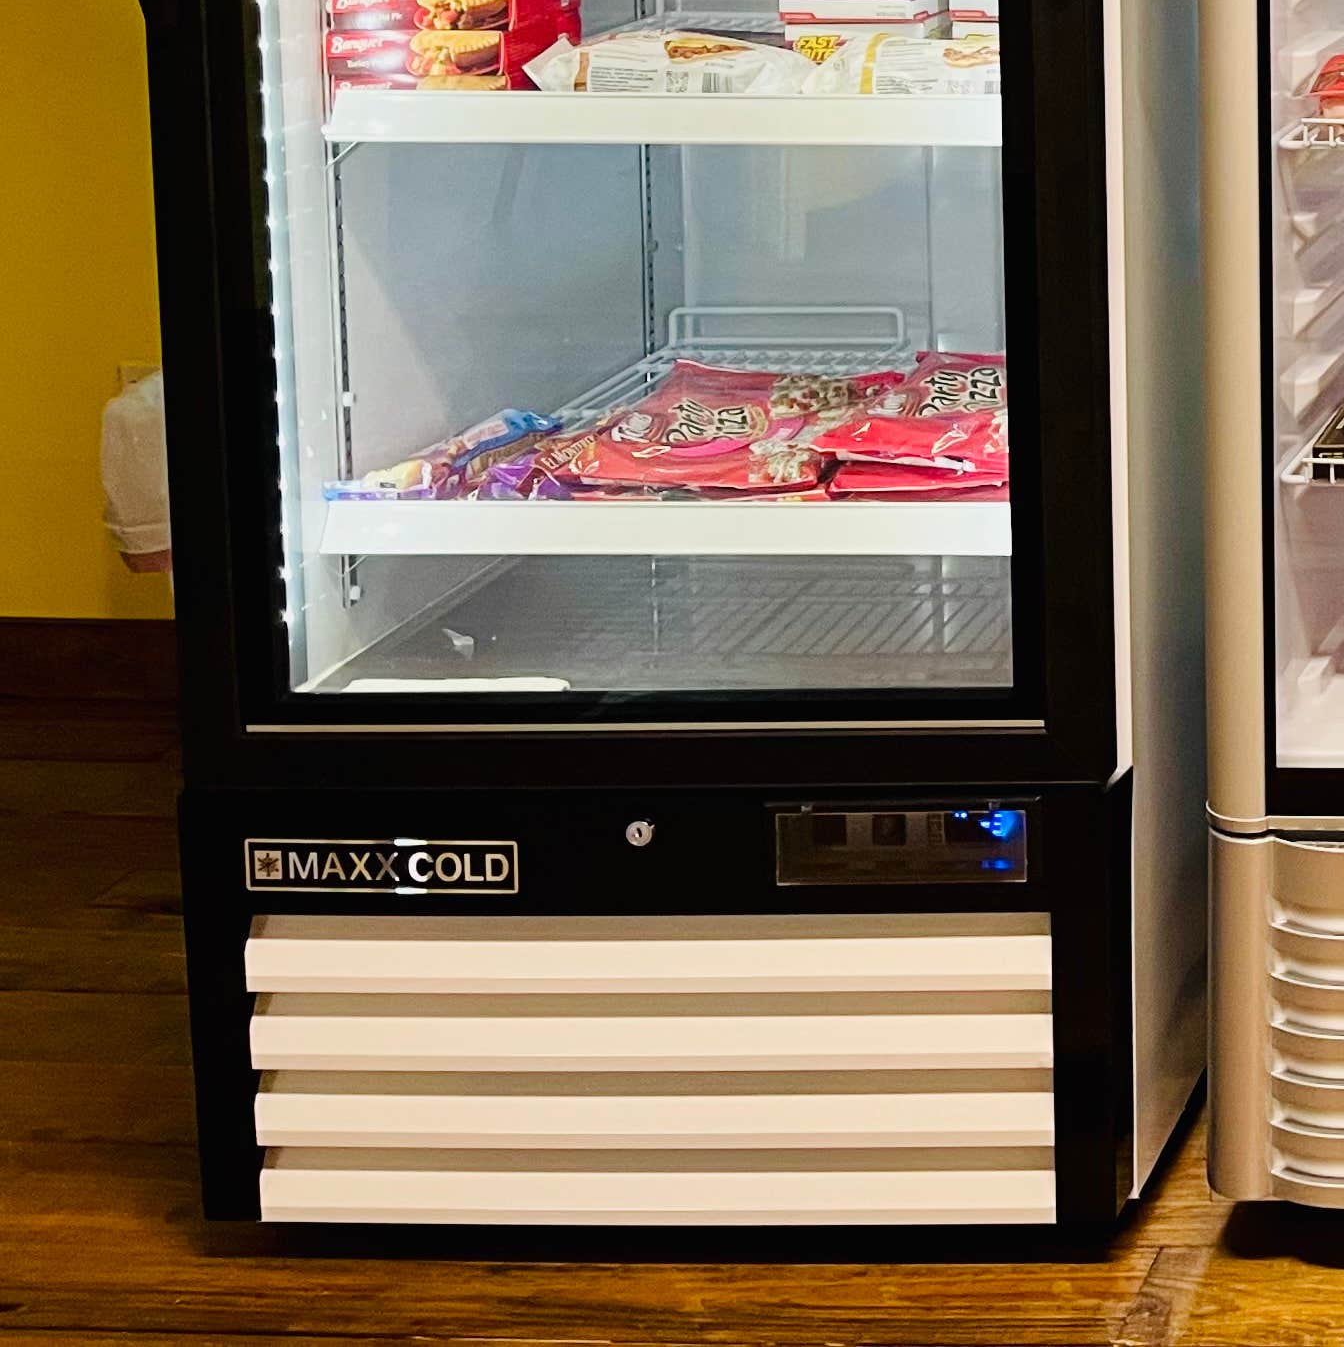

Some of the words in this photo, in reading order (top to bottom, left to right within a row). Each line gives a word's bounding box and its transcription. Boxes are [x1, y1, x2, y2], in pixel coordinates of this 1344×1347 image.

[798, 35, 842, 48] FAST
[288, 851, 399, 882] MAXX
[408, 851, 510, 883] COLD
